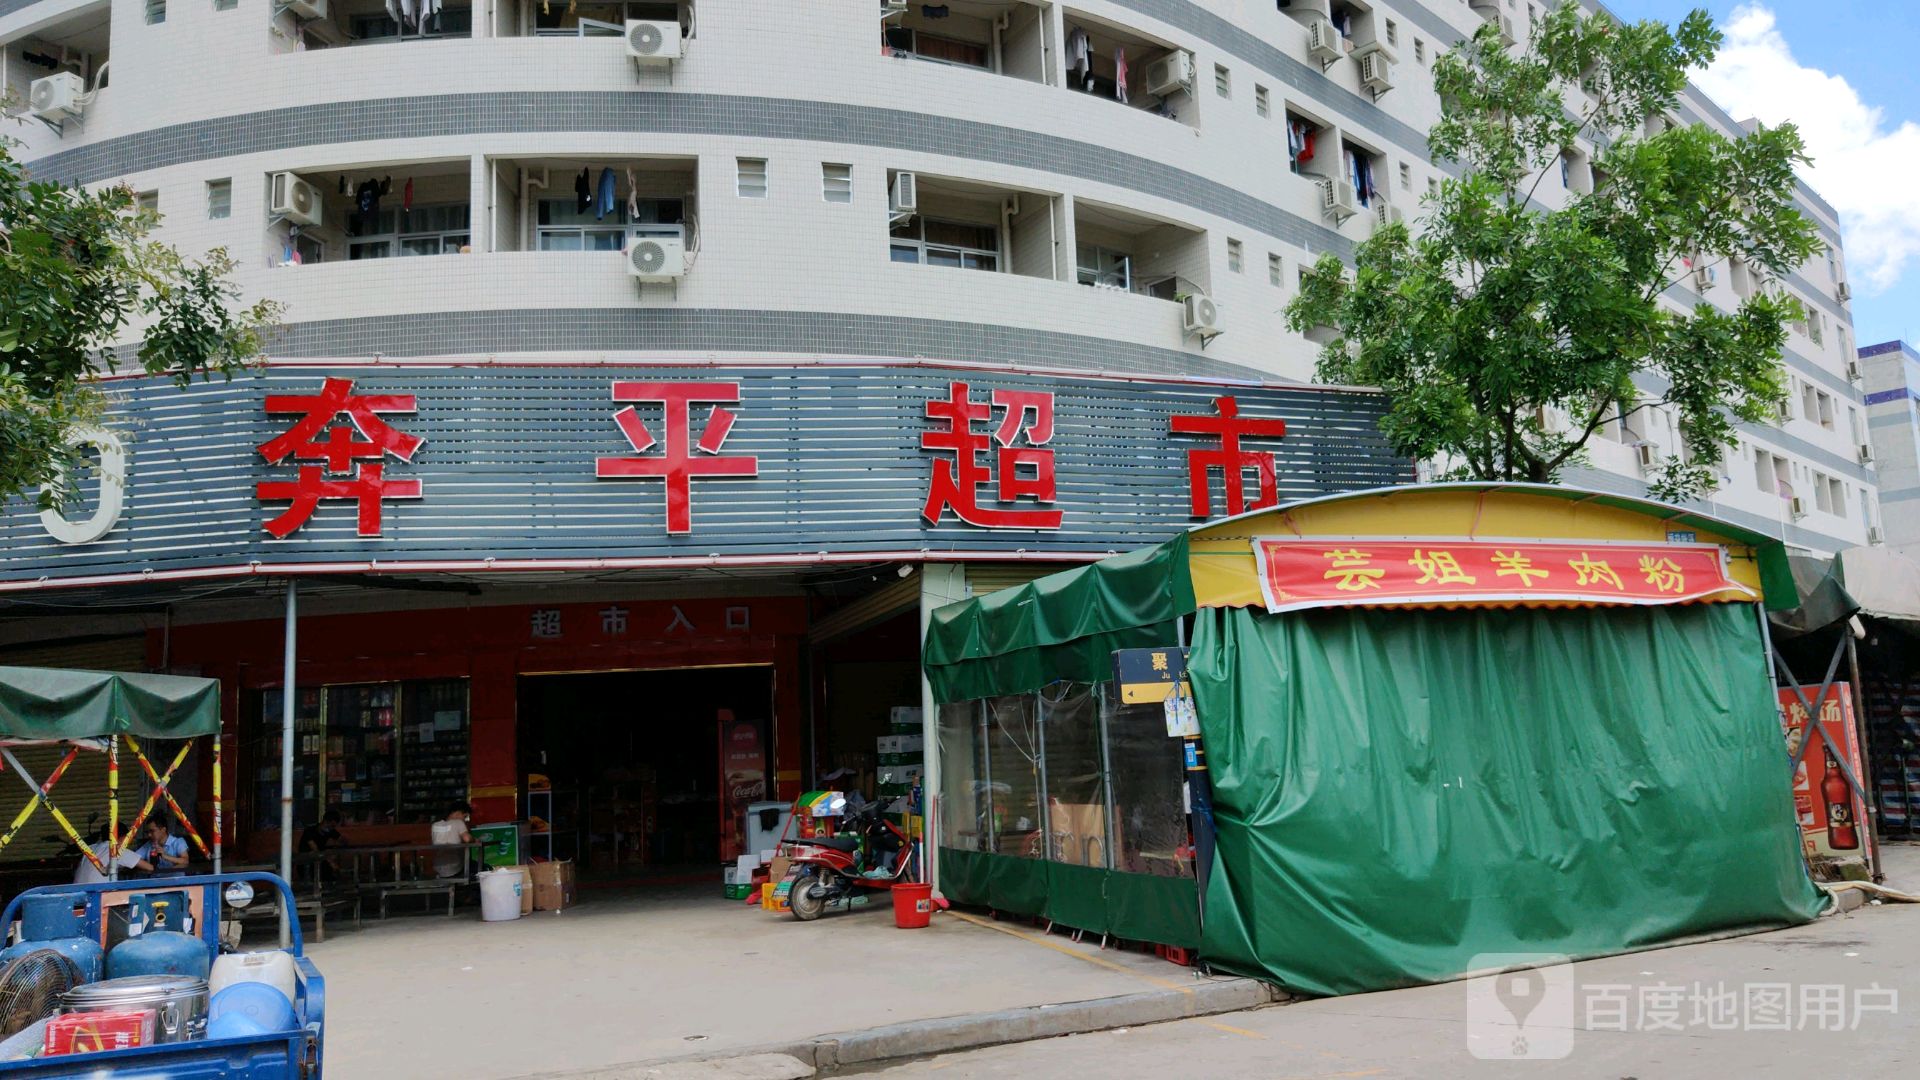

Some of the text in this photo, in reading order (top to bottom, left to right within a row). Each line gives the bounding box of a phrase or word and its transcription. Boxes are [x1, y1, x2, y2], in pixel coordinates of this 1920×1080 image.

[257, 376, 1286, 538] 奔平超市
[1323, 548, 1685, 593] 芸姐羊肉粉
[530, 605, 751, 638] 超市入口
